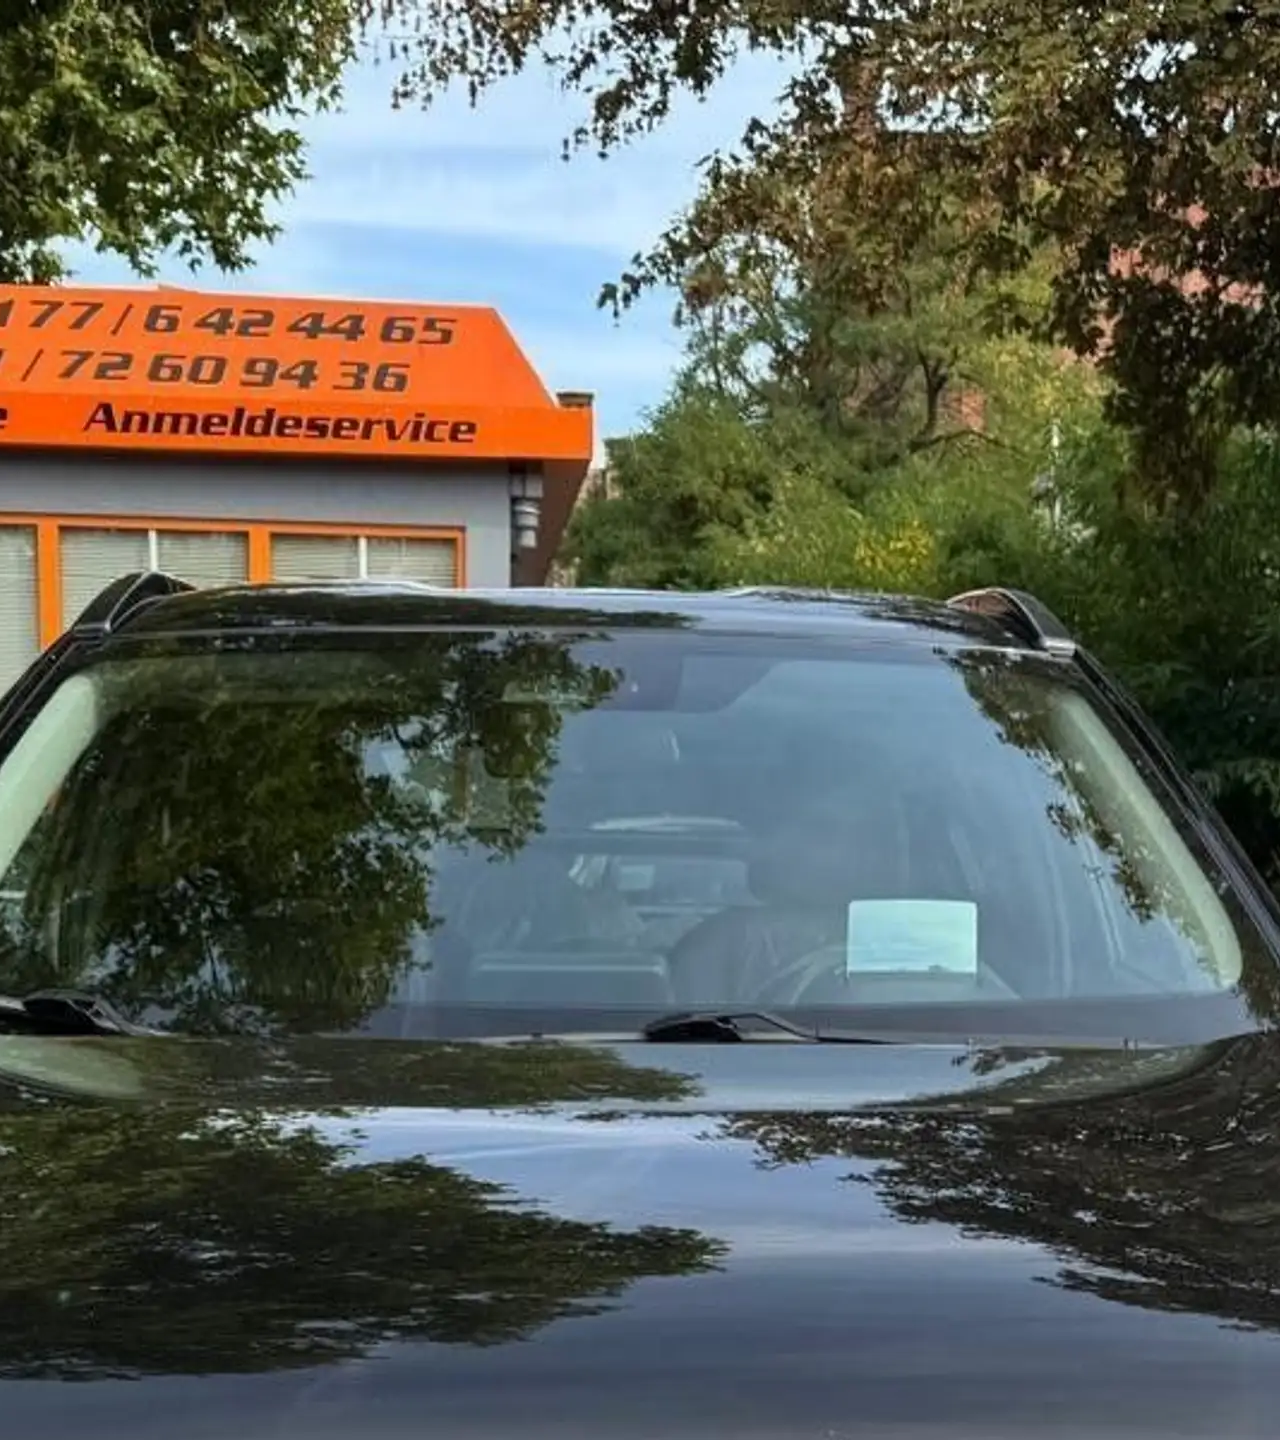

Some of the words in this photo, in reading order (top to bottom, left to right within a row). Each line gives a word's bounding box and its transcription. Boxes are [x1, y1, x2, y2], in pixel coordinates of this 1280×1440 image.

[194, 307, 274, 337] 42
[286, 312, 366, 342] 44
[379, 316, 457, 345] 65
[57, 351, 133, 381] 72
[147, 353, 228, 385] 60
[240, 357, 318, 390] 94
[333, 361, 410, 393] 36
[83, 402, 478, 444] Anmeldeservice
